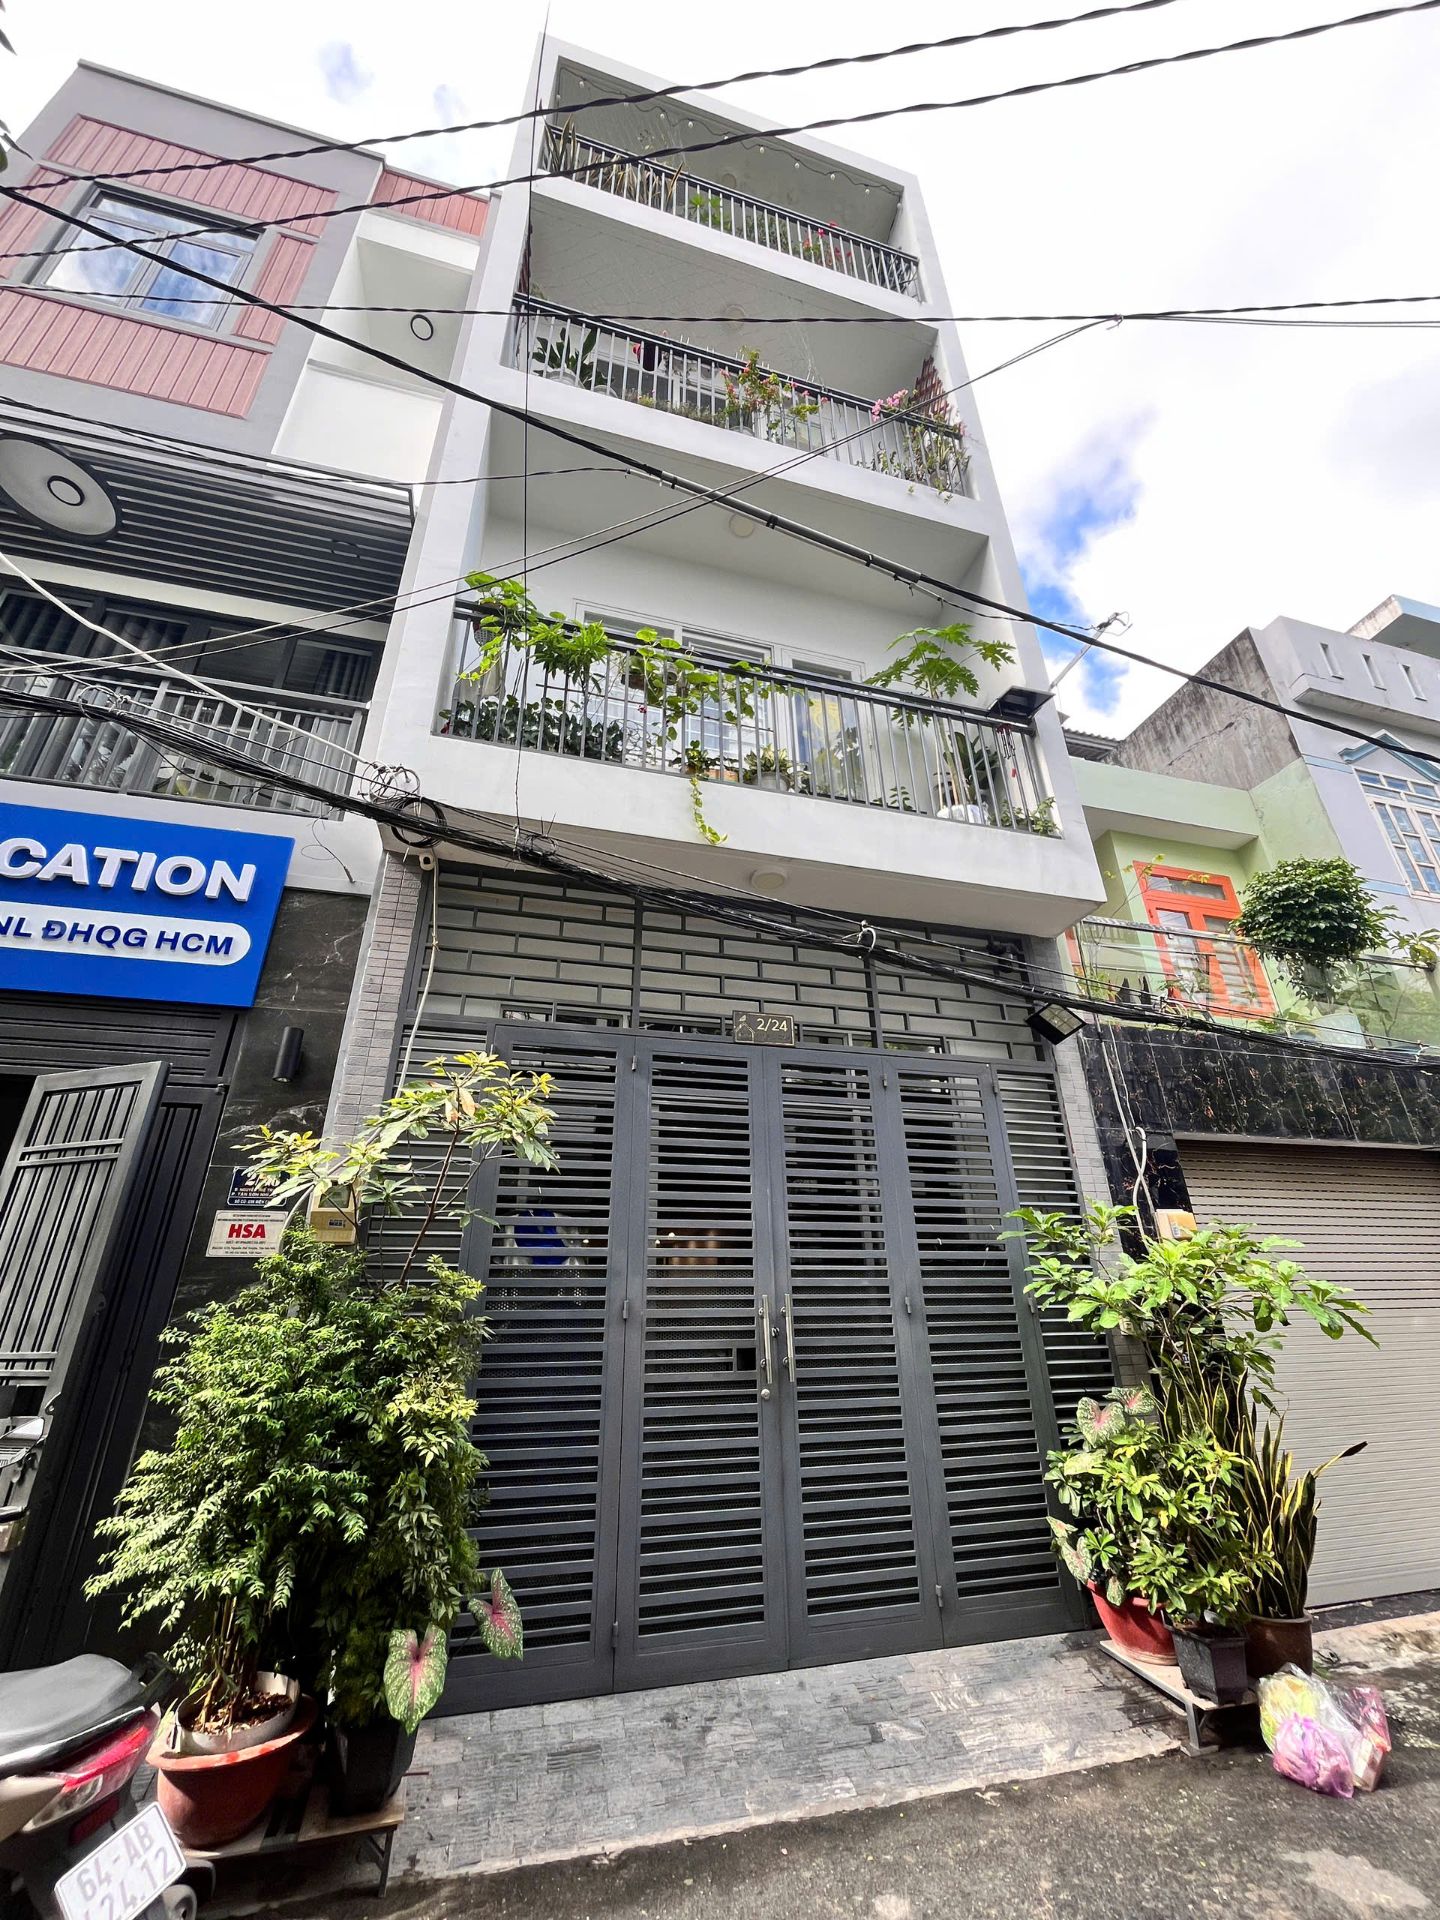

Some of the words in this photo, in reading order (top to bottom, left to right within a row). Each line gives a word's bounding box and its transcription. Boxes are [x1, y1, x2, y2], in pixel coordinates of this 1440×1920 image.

[0, 837, 257, 902] CATION
[41, 919, 148, 949] ĐHQG
[155, 930, 234, 956] HCM
[756, 1018, 788, 1032] 2/24
[228, 1223, 266, 1239] HSA
[76, 1820, 154, 1901] 64-AB
